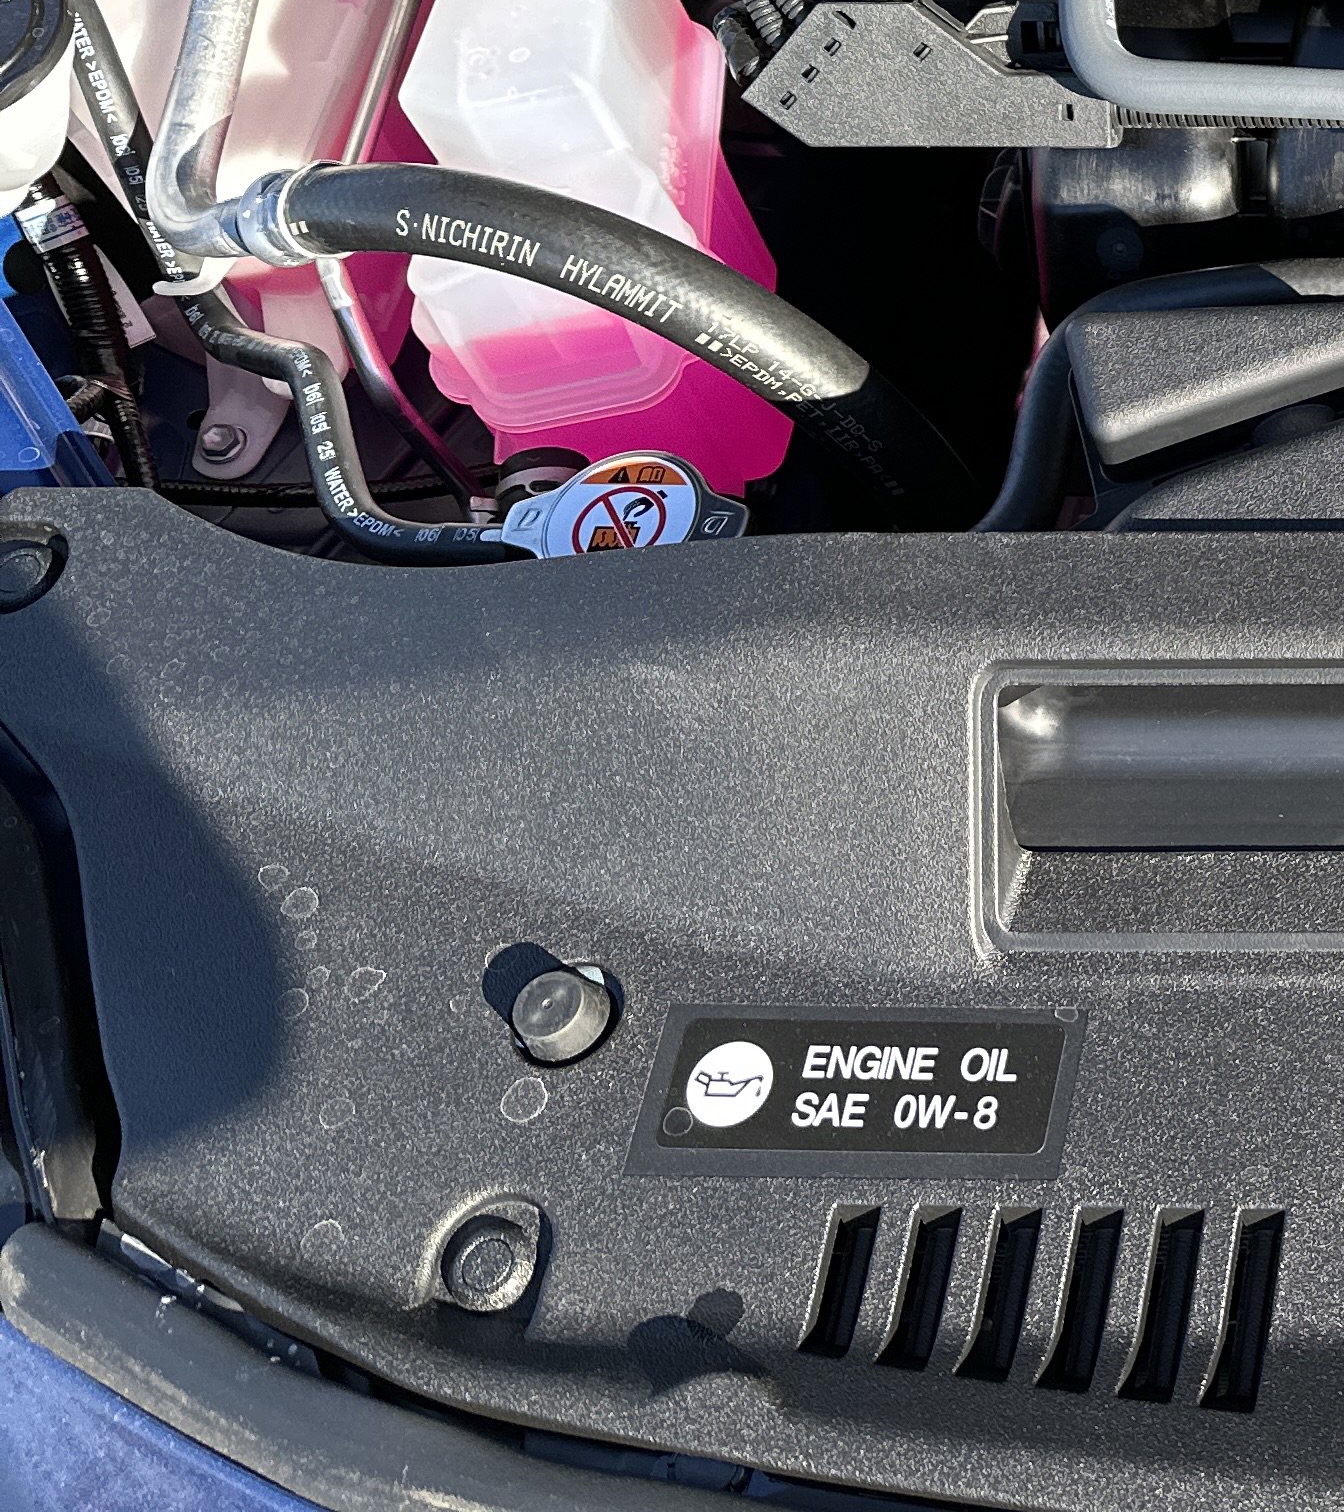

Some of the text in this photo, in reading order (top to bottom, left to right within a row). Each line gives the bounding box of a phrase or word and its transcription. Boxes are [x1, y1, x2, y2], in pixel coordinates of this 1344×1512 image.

[559, 254, 684, 324] HYLAMMIT
[323, 465, 355, 513] WATER
[801, 1045, 1017, 1082] ENGINE OIL
[790, 1092, 998, 1130] SAE 0W-8
